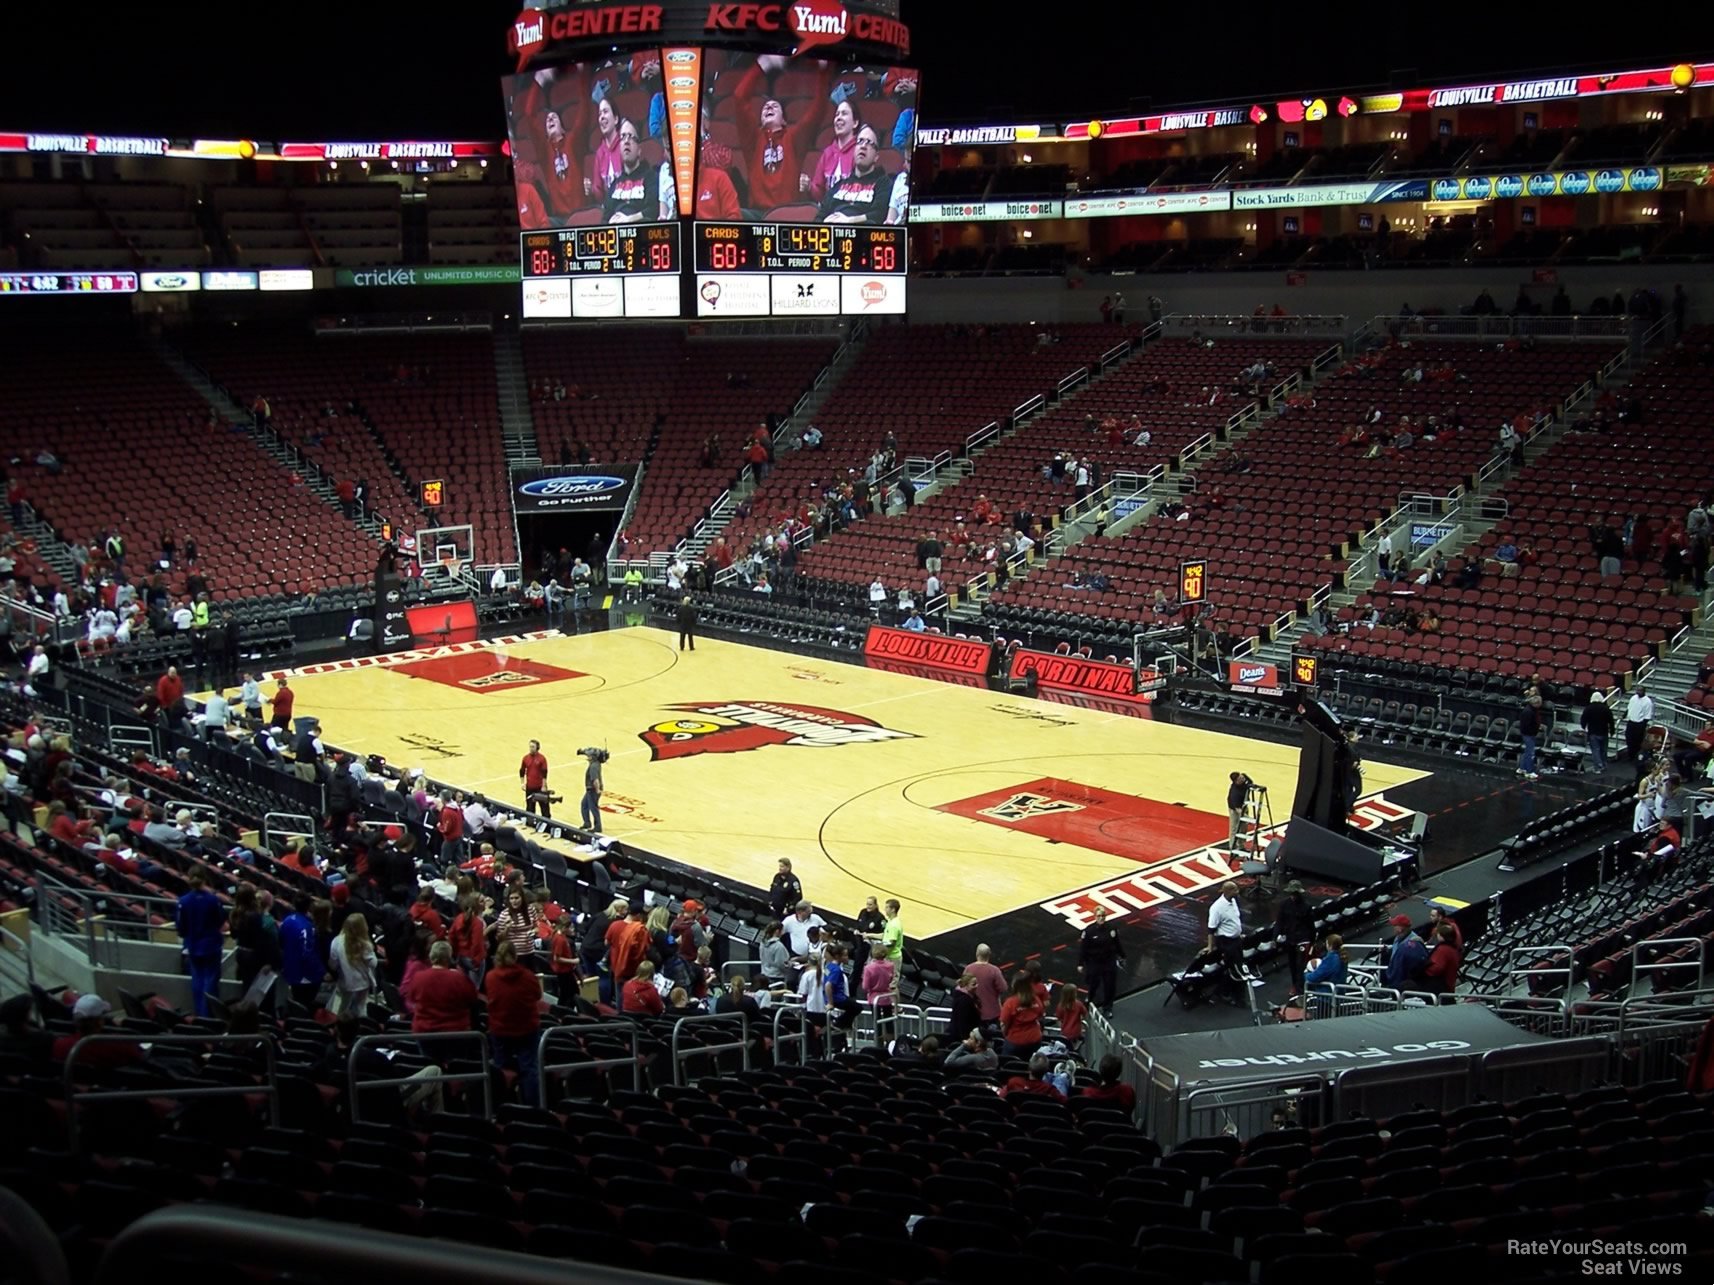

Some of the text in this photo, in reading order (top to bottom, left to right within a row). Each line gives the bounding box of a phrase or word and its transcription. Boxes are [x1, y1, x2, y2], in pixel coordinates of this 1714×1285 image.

[515, 4, 663, 47] Yum! CENTER
[705, 3, 780, 30] KFC
[794, 5, 847, 35] Yum!
[1434, 80, 1578, 107] LOUISVILLE BASKETBALL
[1160, 112, 1207, 131] LOUISVILLE
[27, 135, 164, 154] LOUISVILLE BASKETBALL
[952, 127, 1016, 142] BASKETBALL
[325, 143, 453, 158] LOUISVILLE BASKETBALL
[1236, 189, 1367, 206] Stock Yards Bank & Trust
[586, 229, 615, 254] 4:42
[705, 227, 895, 252] CARDS TM FLS 4:42 TM FLS OWLS
[533, 250, 549, 273] 60
[566, 242, 572, 257] 8
[652, 244, 670, 269] 50
[584, 261, 601, 270] PERIOD
[603, 258, 608, 272] 2
[627, 256, 633, 271] 2
[713, 238, 895, 270] 60 8 10 50
[788, 258, 811, 267] PERIOD
[813, 256, 820, 270] 2
[844, 256, 851, 270] 2
[354, 269, 417, 286] cricket
[475, 271, 503, 279] MUSIC
[541, 480, 604, 493] Ford
[561, 494, 613, 504] Further
[1184, 577, 1200, 598] 90
[258, 628, 569, 682] LOUISVILLE
[874, 631, 984, 668] LOUISVILLE
[1298, 668, 1312, 682] 90
[1199, 1040, 1471, 1068] Go Further
